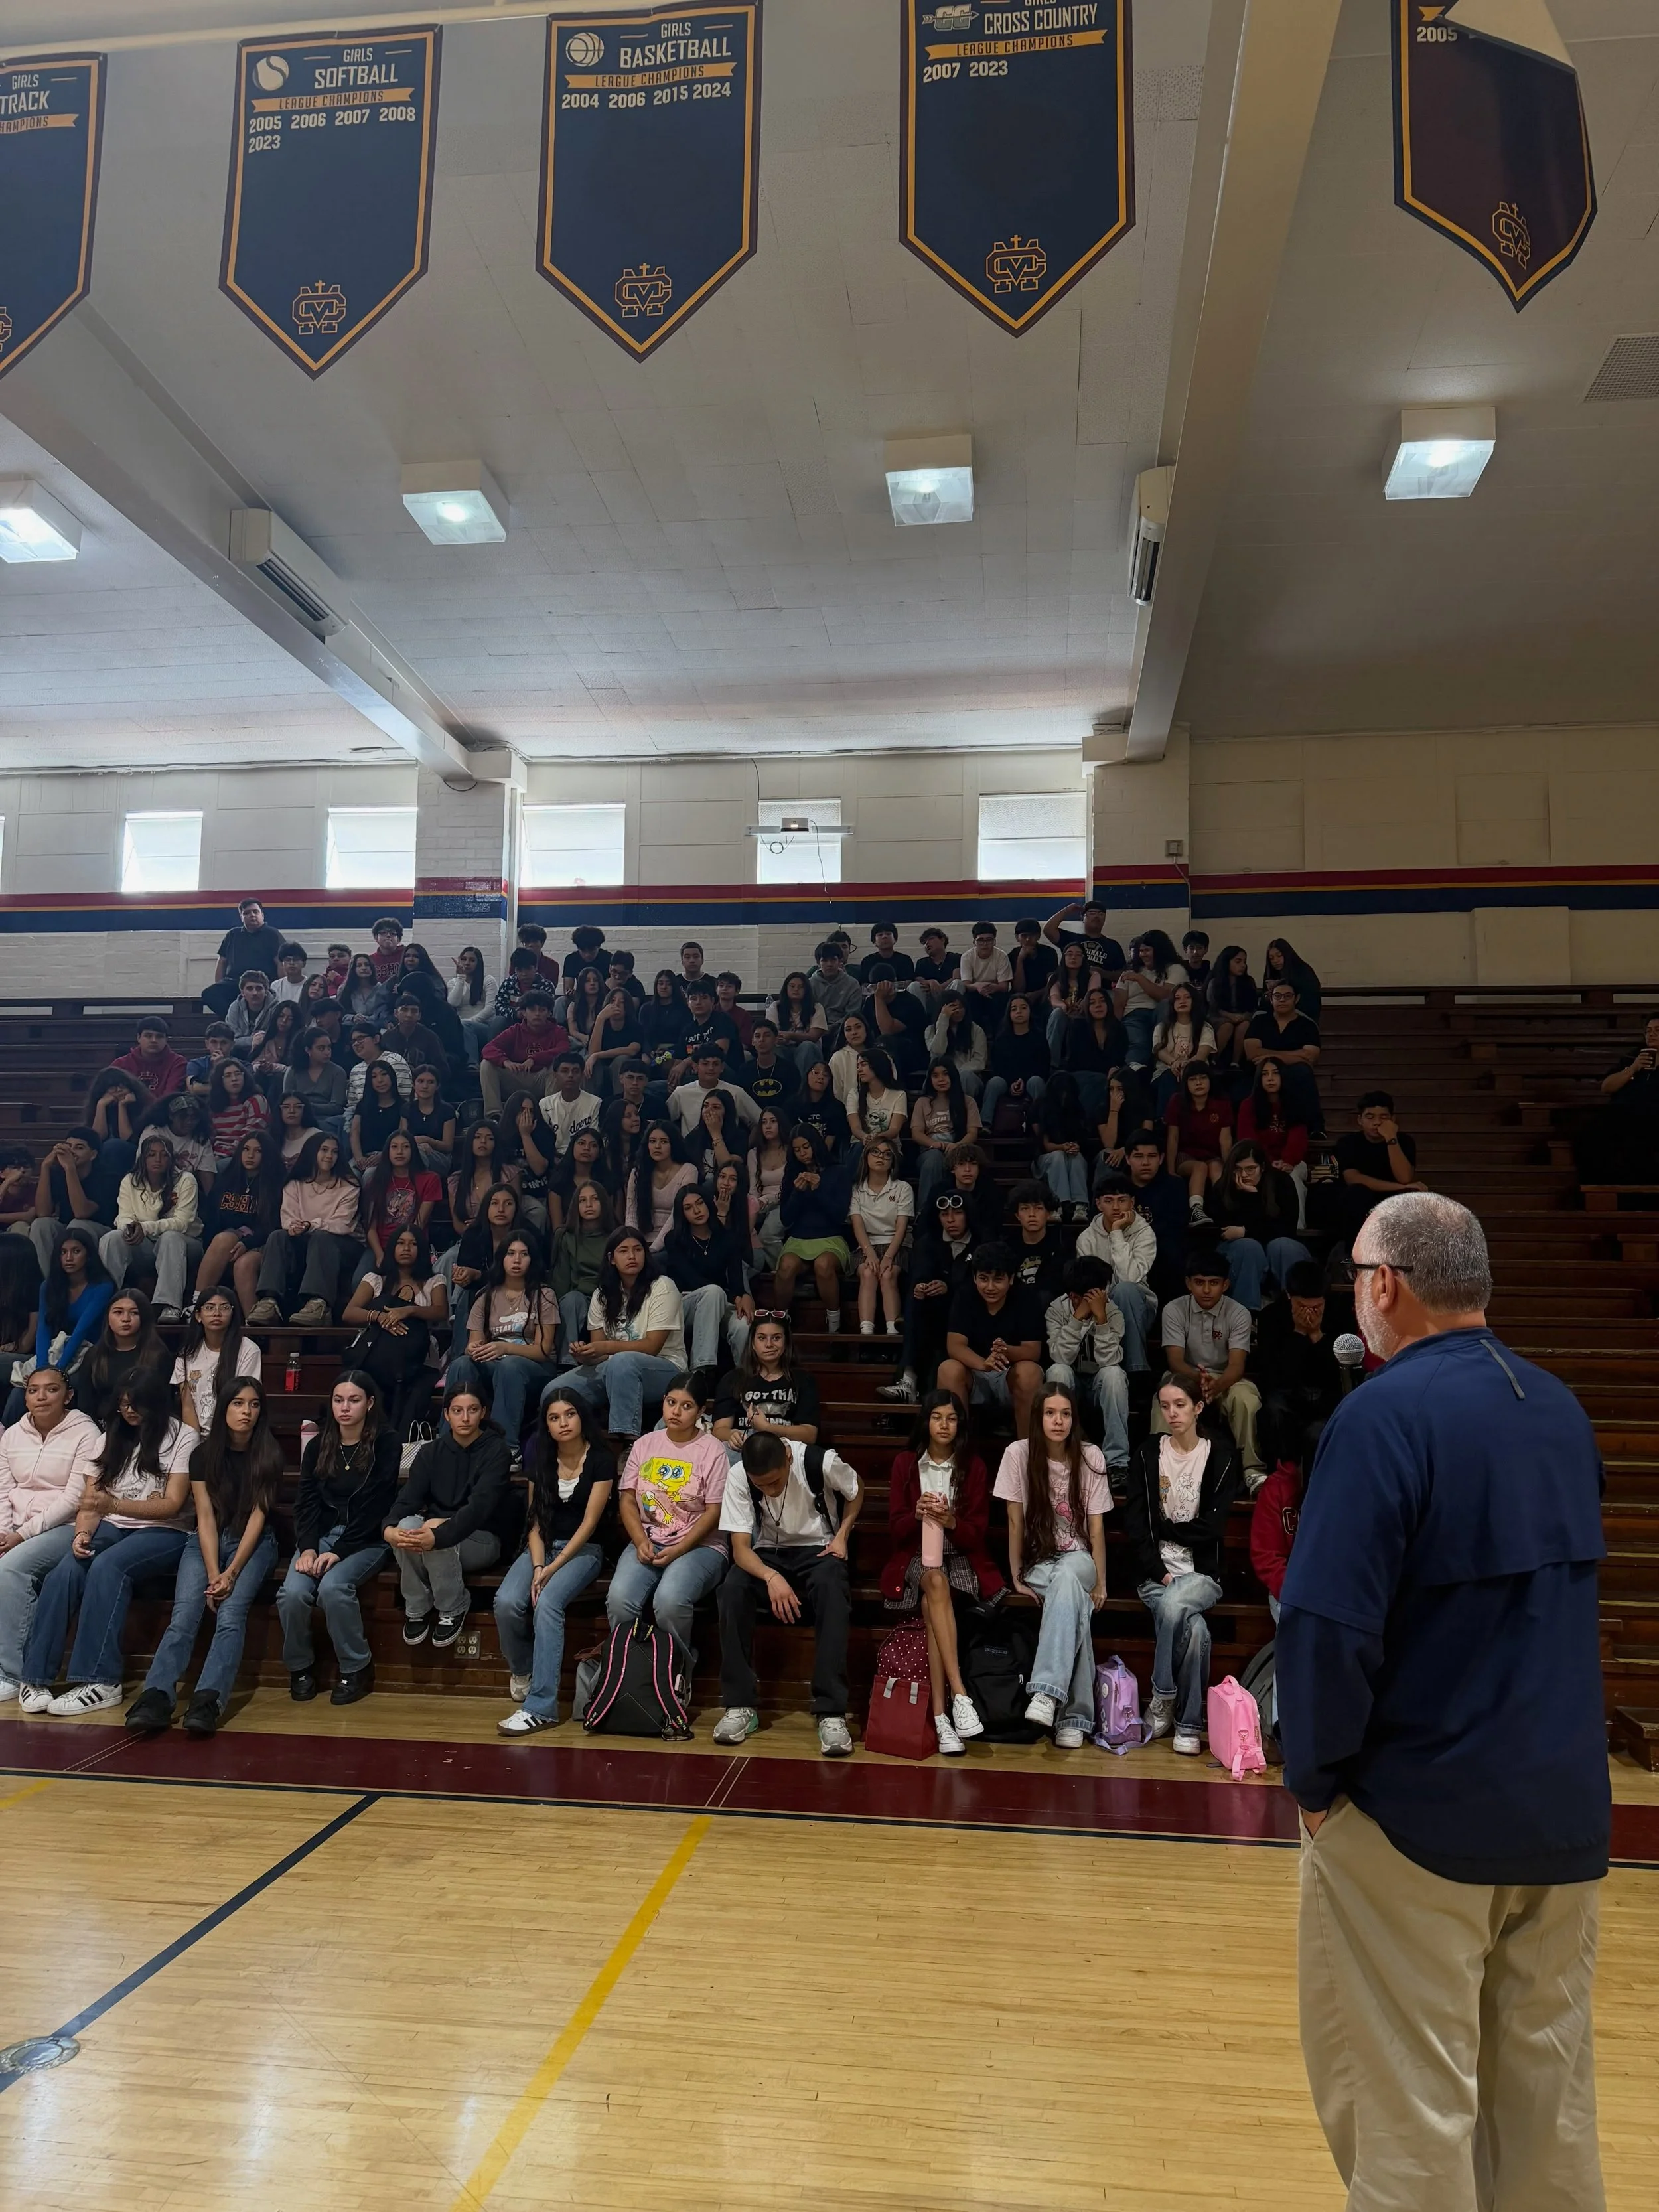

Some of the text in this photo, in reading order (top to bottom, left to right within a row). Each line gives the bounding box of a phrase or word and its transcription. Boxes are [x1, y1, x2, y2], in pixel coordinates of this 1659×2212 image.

[984, 3, 1098, 34] CROSS COUNTRY
[661, 22, 691, 38] GIRLS
[1417, 26, 1458, 42] 2005
[343, 48, 373, 62] GIRLS
[620, 37, 731, 68] BASKETBALL
[956, 35, 1073, 56] LEAGUE CHAMPIONS
[12, 74, 39, 90] GIRLS
[315, 63, 398, 89] SOFTBALL
[595, 66, 704, 87] LEAGUE CHAMPIONS
[922, 60, 1008, 83] 2007 2023
[0, 90, 50, 115] TRACK
[279, 91, 384, 109] LEAGUE CHAMPIONS
[561, 82, 731, 110] 2004 2006 2015 2024
[249, 106, 416, 134] 2005 2006 2007 2008
[248, 135, 281, 153] 2023
[745, 1391, 770, 1402] GOT
